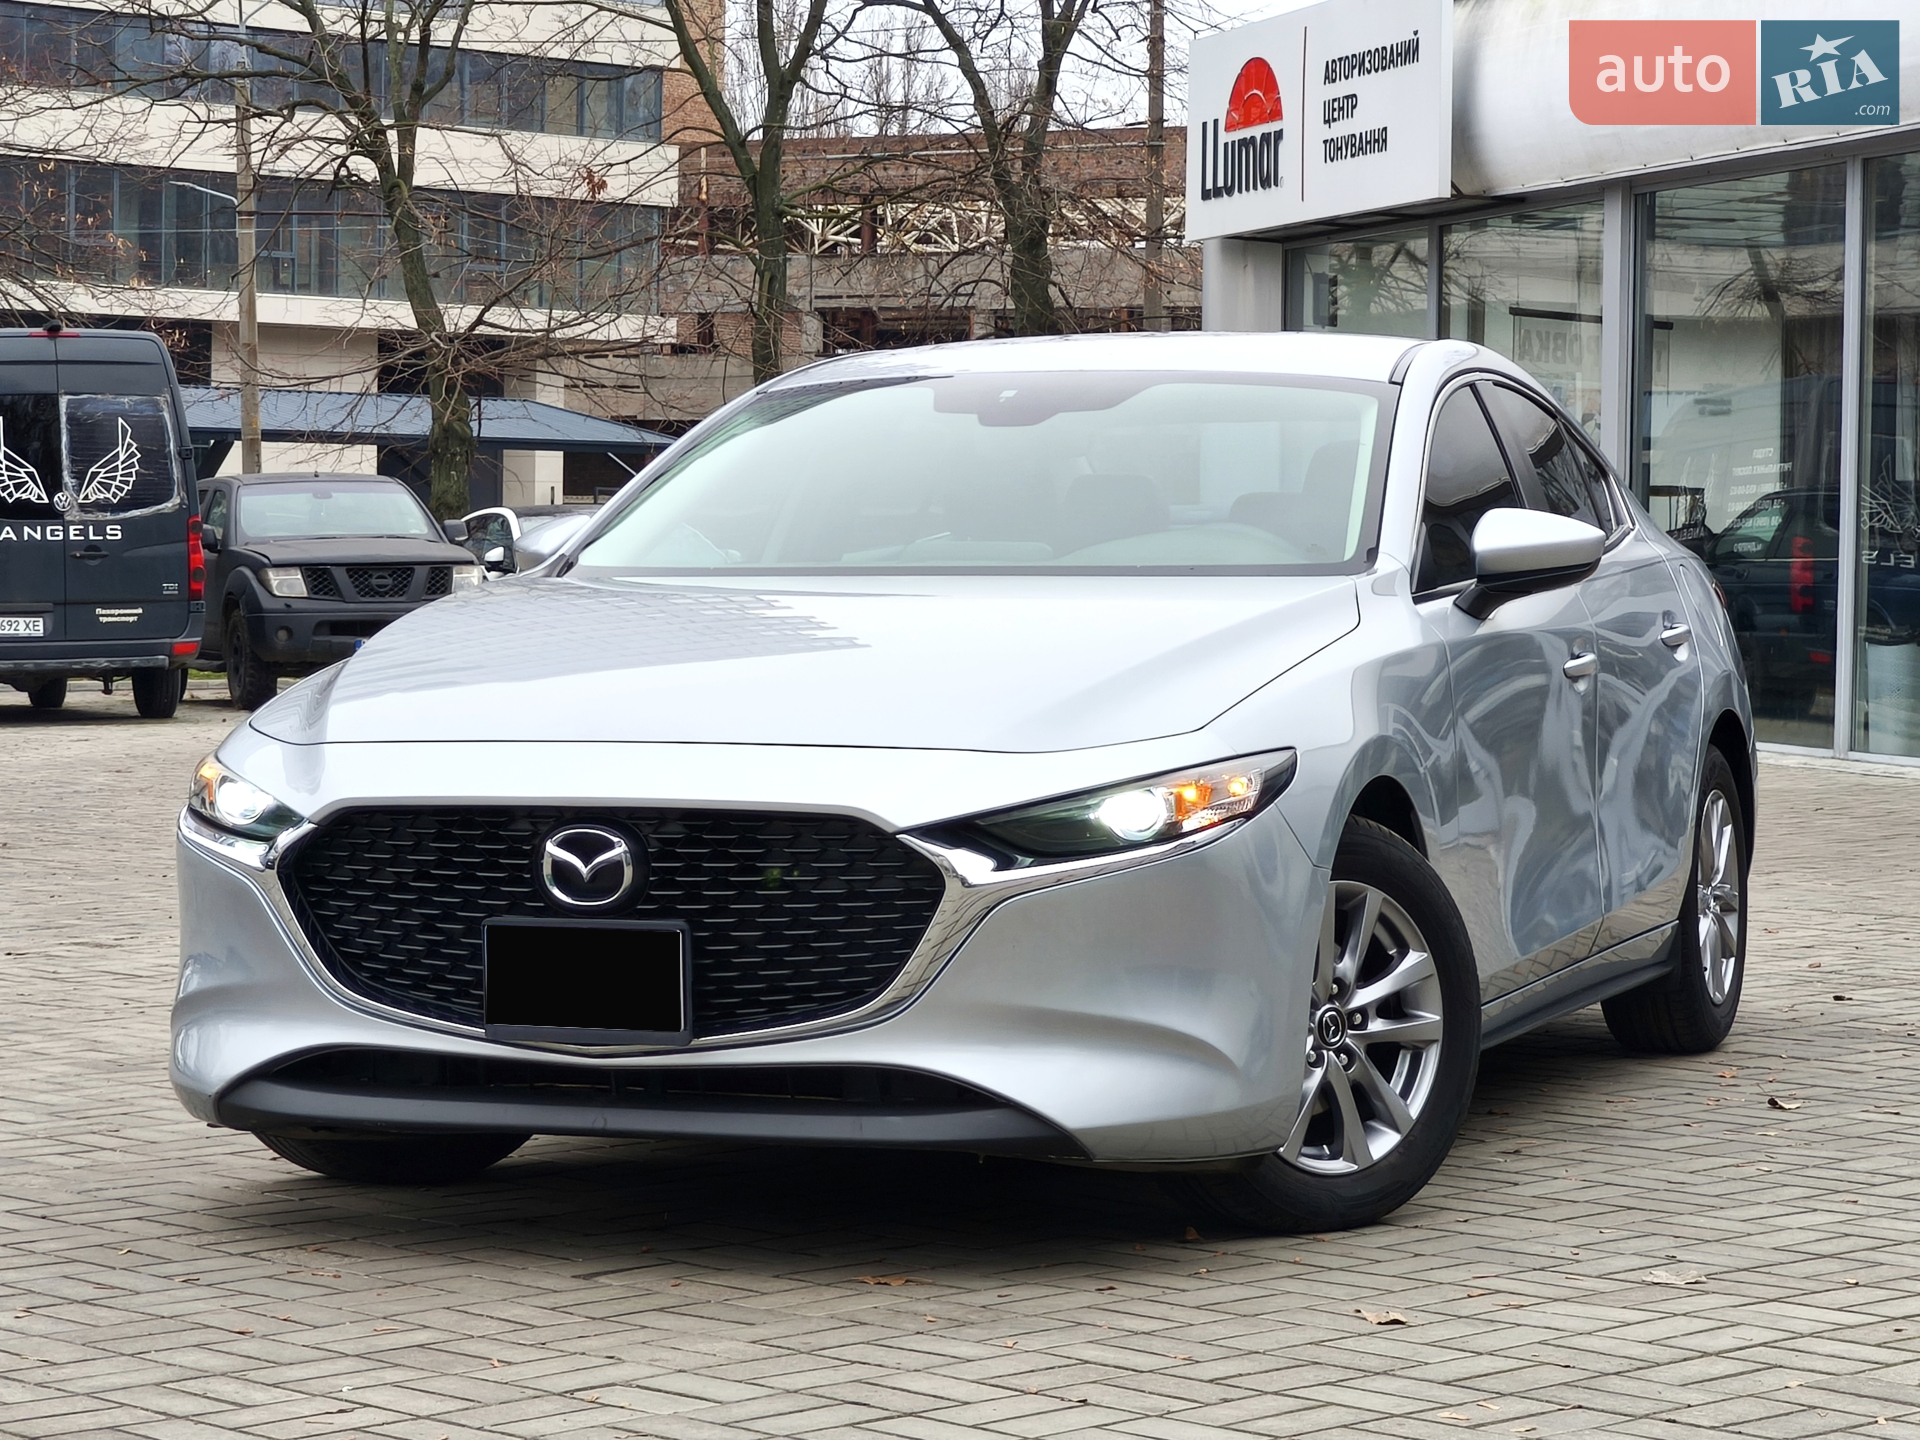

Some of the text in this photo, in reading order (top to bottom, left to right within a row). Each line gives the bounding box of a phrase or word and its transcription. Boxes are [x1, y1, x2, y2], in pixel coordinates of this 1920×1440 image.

[1323, 30, 1420, 86] АВТОРИЗОВАНИЙ
[1323, 93, 1359, 129] ЦЕНТР
[1201, 118, 1283, 202] LLumar
[1322, 126, 1388, 164] ТОНУВАННЯ
[0, 525, 123, 541] ANGELS
[0, 619, 20, 632] 692
